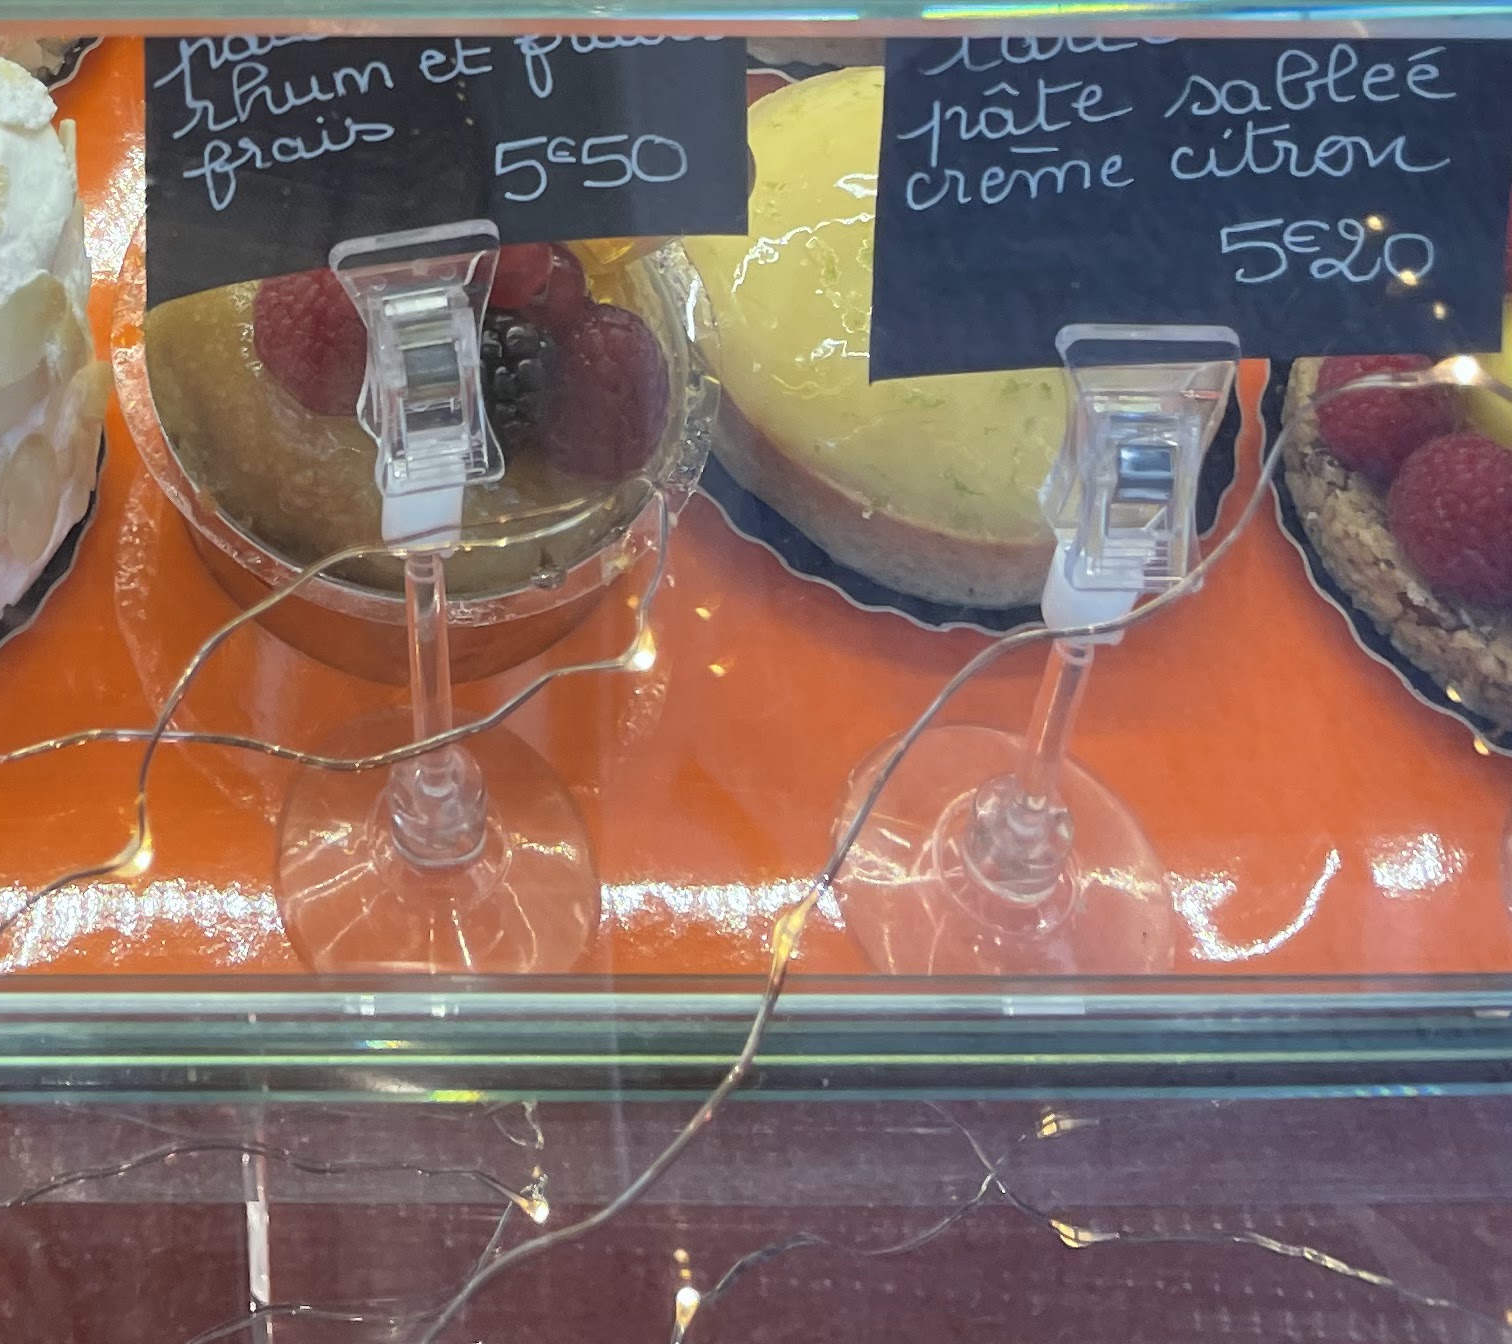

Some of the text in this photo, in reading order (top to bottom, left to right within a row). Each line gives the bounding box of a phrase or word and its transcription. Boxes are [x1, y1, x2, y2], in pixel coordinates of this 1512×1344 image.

[172, 60, 396, 139] rhum
[419, 38, 494, 84] et
[897, 78, 1134, 167] pâte
[182, 117, 396, 211] frais
[1170, 119, 1452, 181] citron
